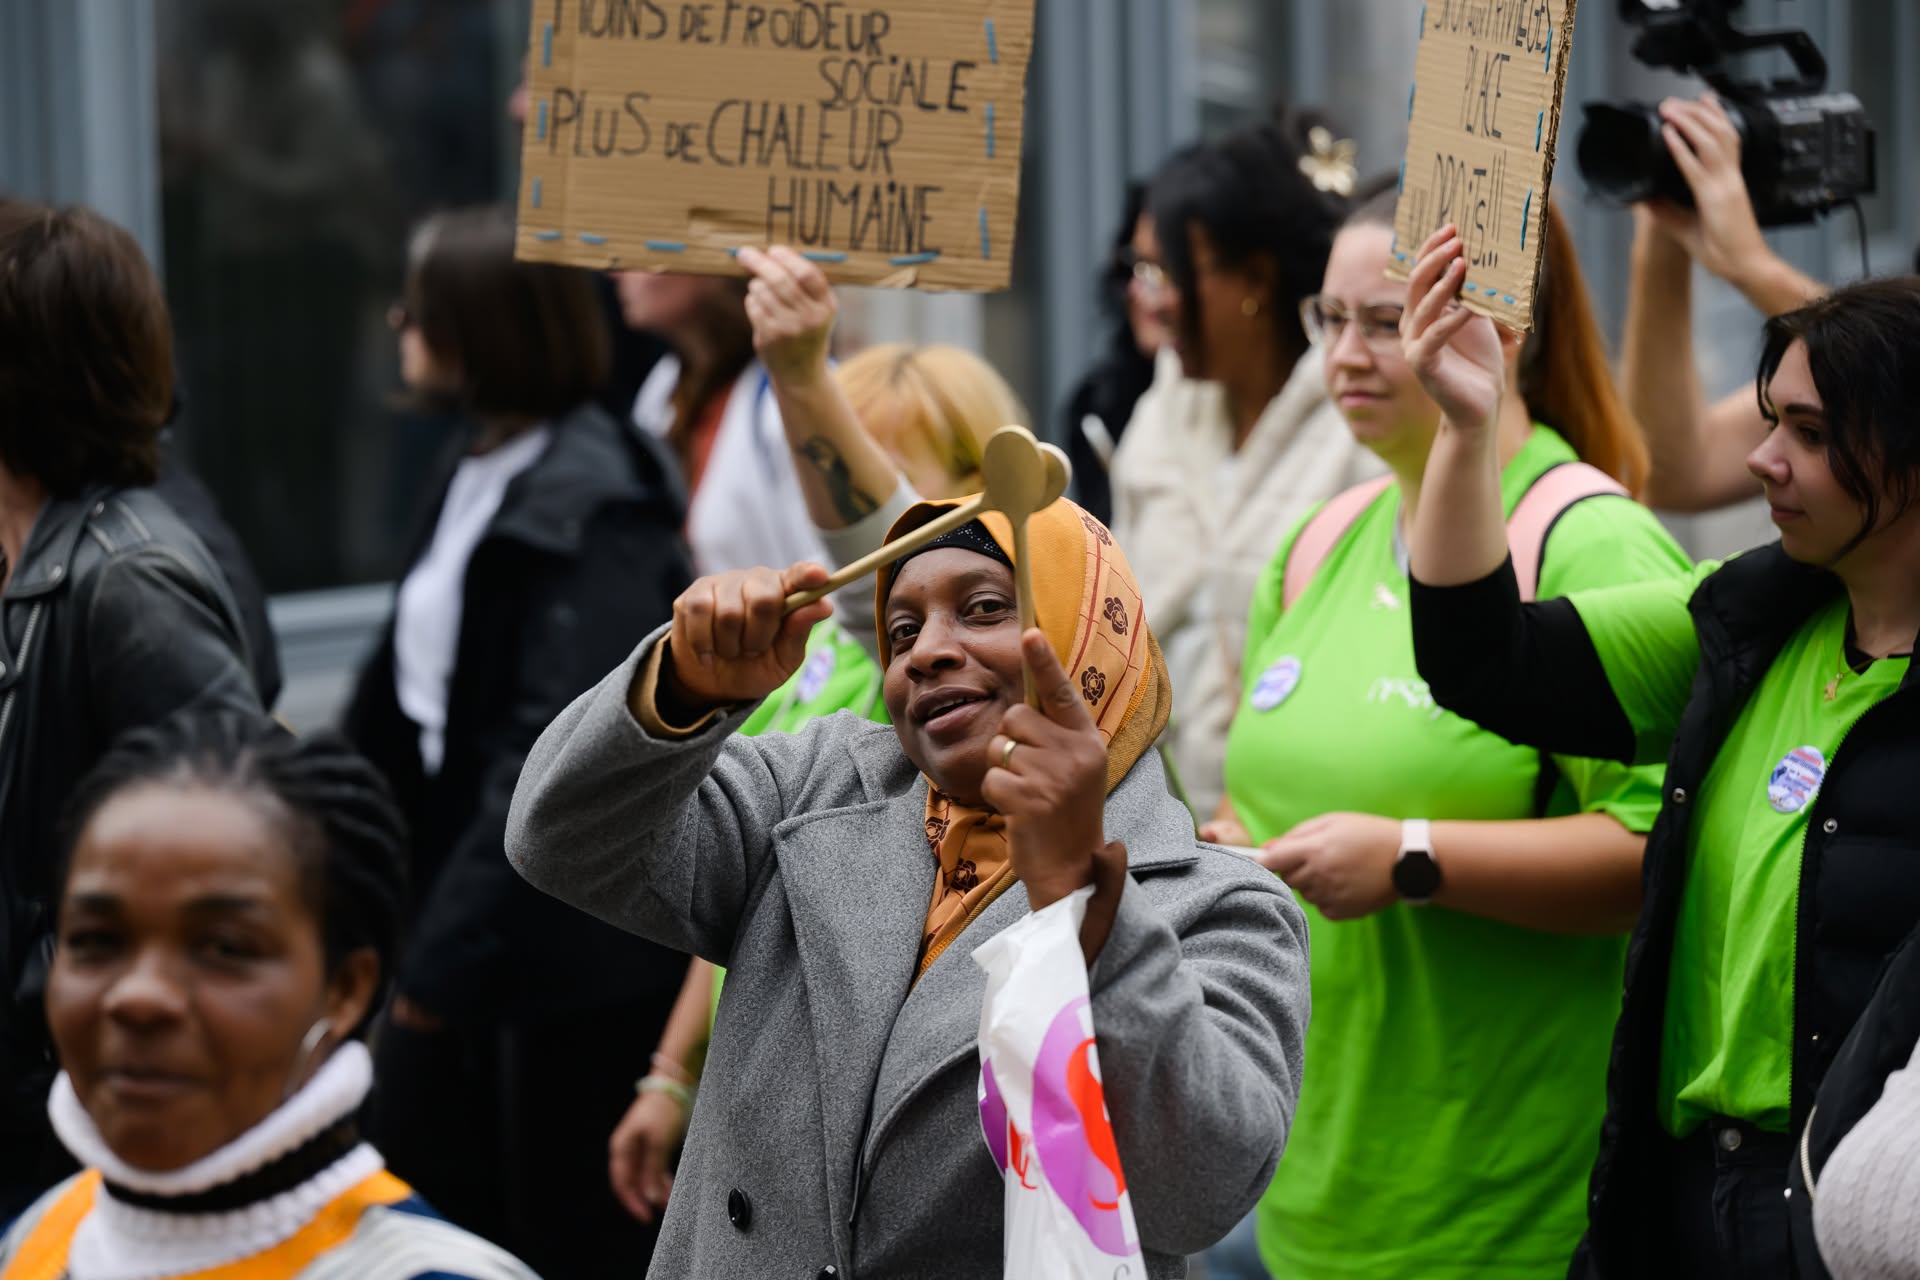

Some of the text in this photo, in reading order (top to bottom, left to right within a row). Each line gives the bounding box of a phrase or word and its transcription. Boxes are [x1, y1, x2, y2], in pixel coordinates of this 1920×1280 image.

[679, 4, 714, 43] DE
[550, 88, 903, 175] PLUS DE CHALEUR
[1459, 44, 1511, 139] PLACE
